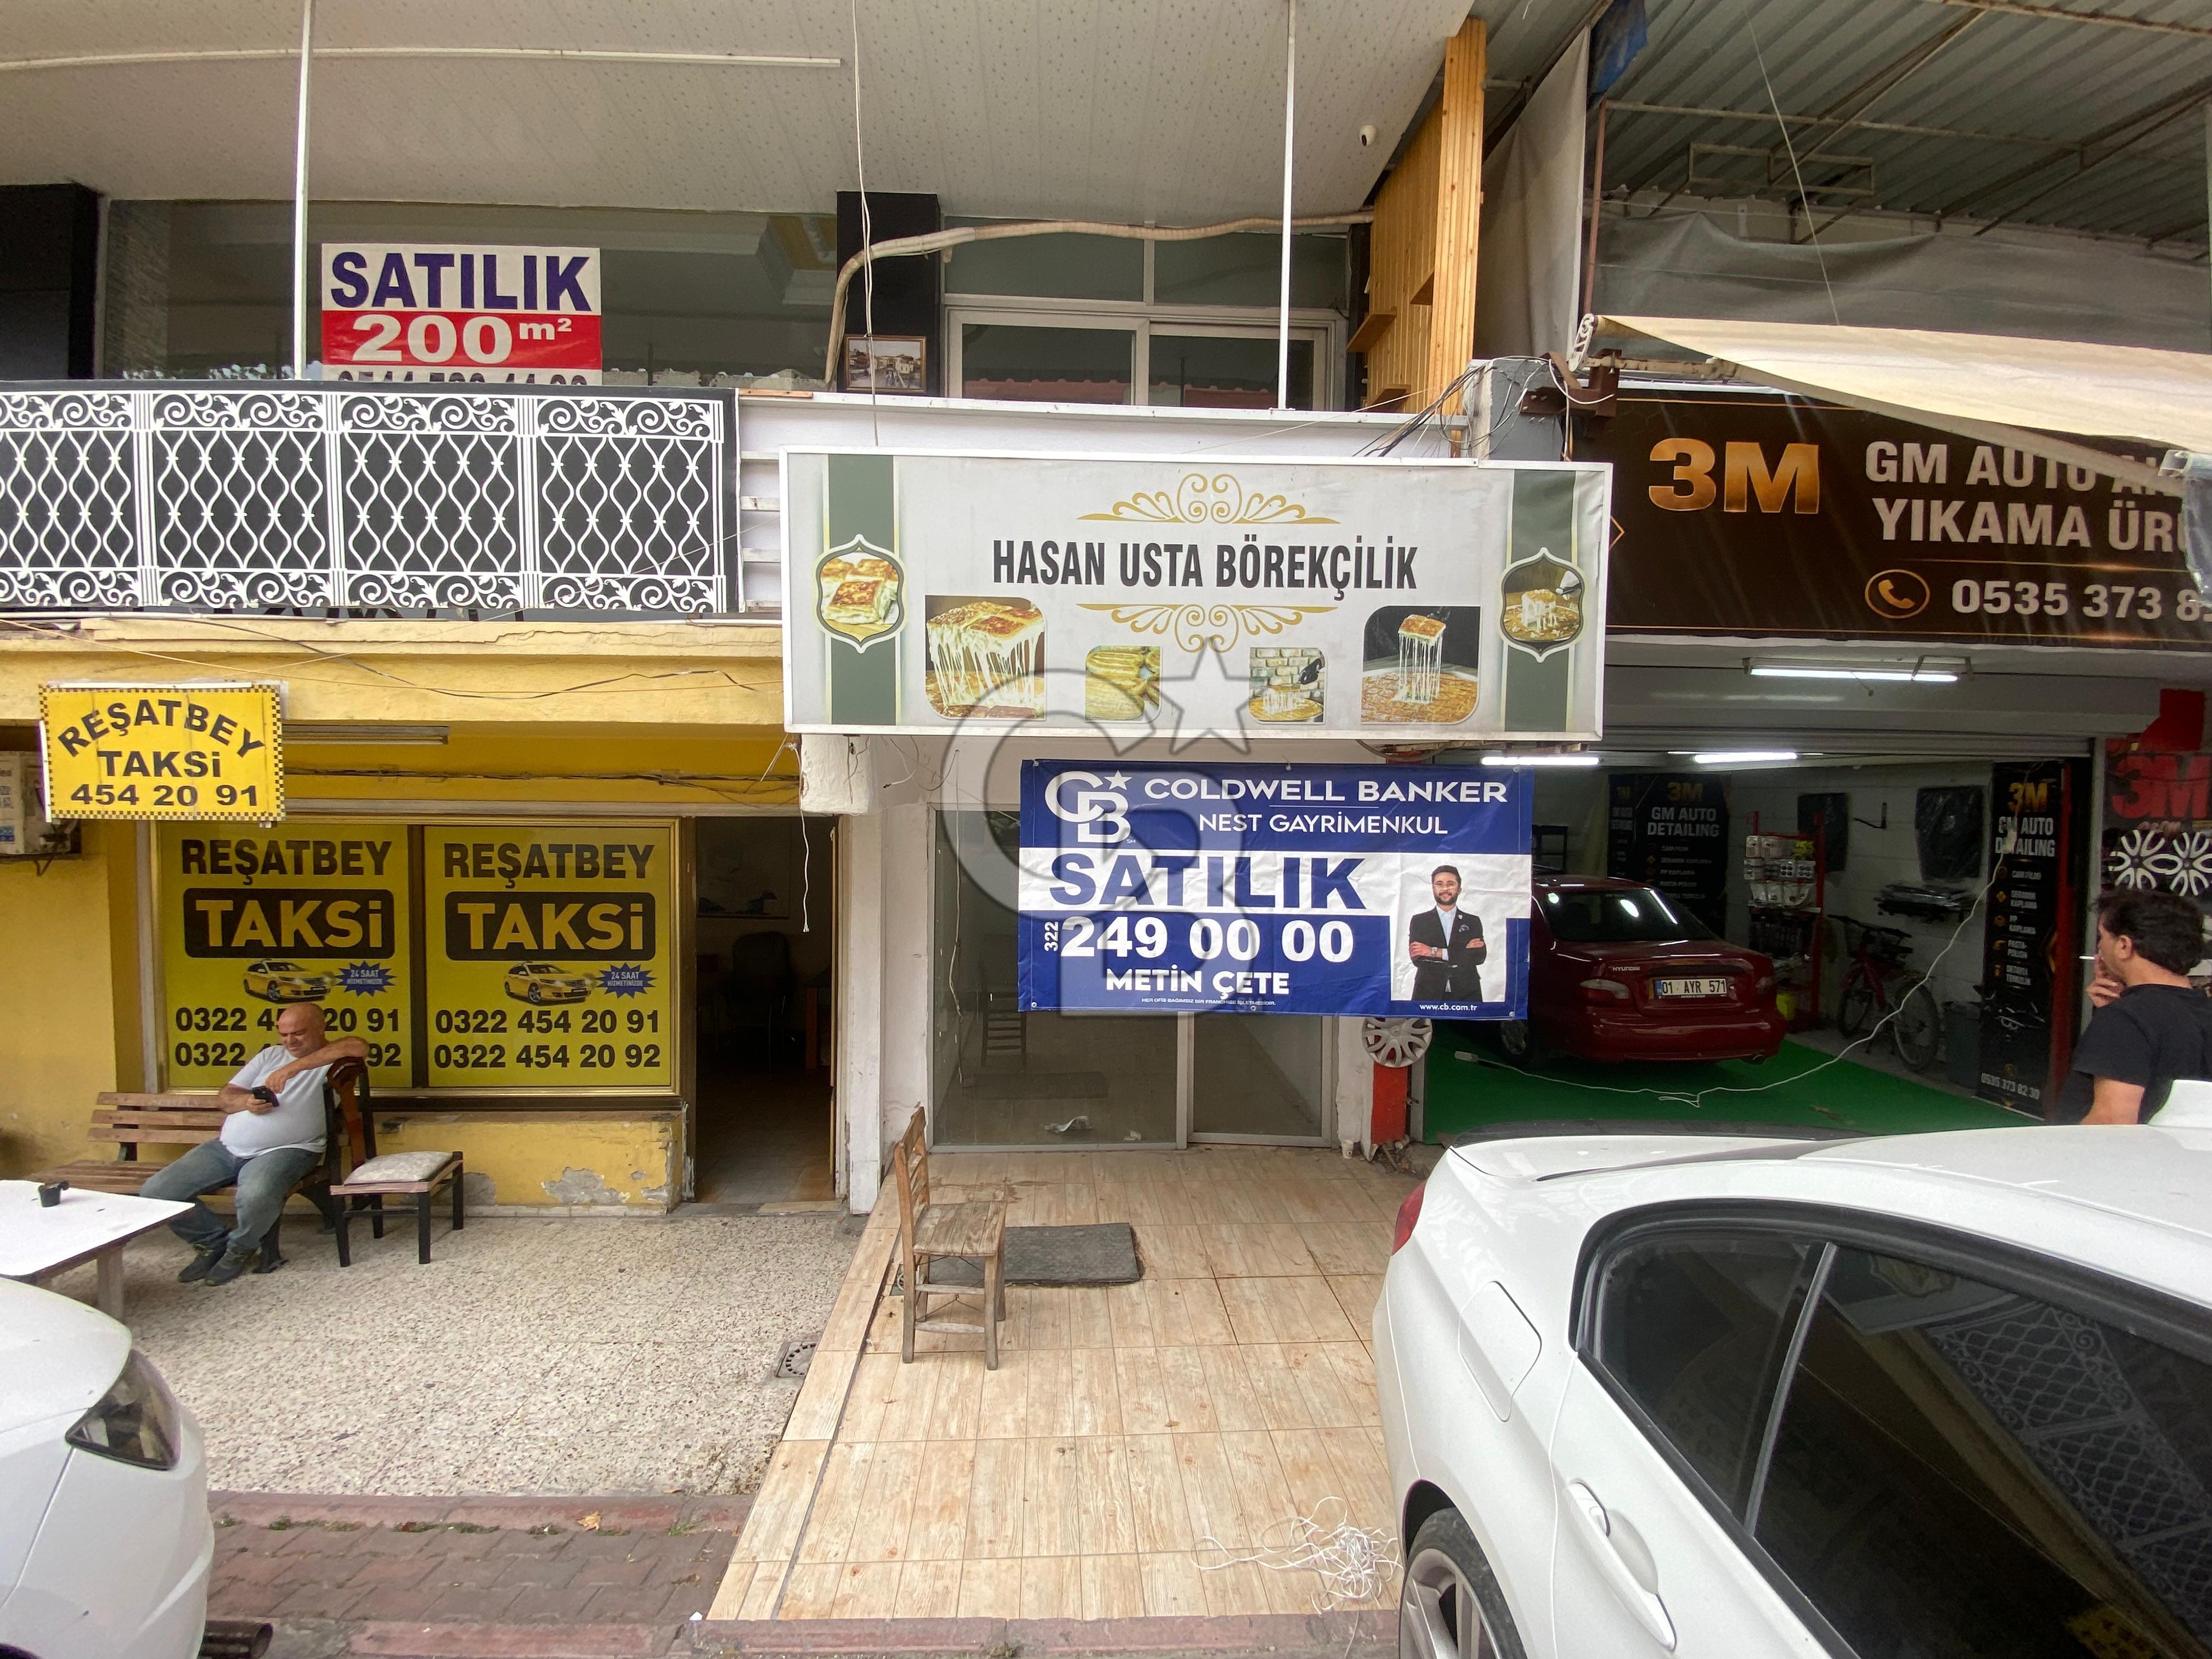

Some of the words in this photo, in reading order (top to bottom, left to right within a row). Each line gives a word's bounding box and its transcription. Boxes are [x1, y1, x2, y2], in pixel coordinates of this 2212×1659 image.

[330, 251, 592, 312] SATILIK
[1649, 437, 1820, 515] 3M
[1865, 441, 1947, 484] GM
[1872, 498, 2092, 548] YIKAMA
[993, 539, 1105, 586] HASAN
[1120, 542, 1204, 588] USTA
[1216, 534, 1418, 601] BÖREKÇİLİK
[1951, 579, 2069, 616] 0535
[2083, 584, 2162, 619] 373
[58, 699, 266, 758] REŞATBEY
[71, 783, 140, 805] 454
[153, 785, 198, 806] 20
[216, 785, 257, 806] 91
[1144, 778, 1345, 801] COLDWELL
[1358, 781, 1508, 803] BANKER
[2006, 781, 2049, 812] 3M
[1199, 814, 1263, 832] NEST
[1269, 811, 1448, 834] GAYRİMENKUL
[1651, 806, 1674, 820] GM
[1677, 807, 1717, 821] AUTO
[2021, 817, 2055, 836] AUTO
[1647, 822, 1720, 837] DETAILING
[181, 839, 392, 885] REŞATBEY
[444, 843, 655, 889] REŞATBEY
[1049, 853, 1367, 910] SATILIK
[1044, 921, 1059, 952] 322
[1060, 916, 1168, 959] 249
[1189, 918, 1261, 961] 00
[1282, 919, 1354, 963] 00
[360, 969, 380, 978] SAAT
[611, 971, 620, 979] 24
[621, 971, 640, 980] SAAT
[1106, 963, 1202, 992] METİN
[1212, 970, 1290, 1000] ÇETE
[1662, 981, 1673, 994] 01
[1684, 980, 1702, 994] AYR
[1709, 979, 1726, 994] 571
[176, 1007, 247, 1031] 0322
[323, 1008, 357, 1032] 20
[367, 1008, 399, 1032] 91
[1419, 1002, 1478, 1011] www.cb.com.tr
[436, 1009, 507, 1034] 0322
[517, 1009, 572, 1034] 454
[582, 1010, 617, 1034] 20
[627, 1009, 658, 1034] 91
[175, 1043, 246, 1066] 0322
[366, 1043, 402, 1067] 92
[434, 1044, 506, 1068] 0322
[516, 1045, 570, 1068] 454
[579, 1044, 616, 1068] 20
[625, 1044, 661, 1068] 92
